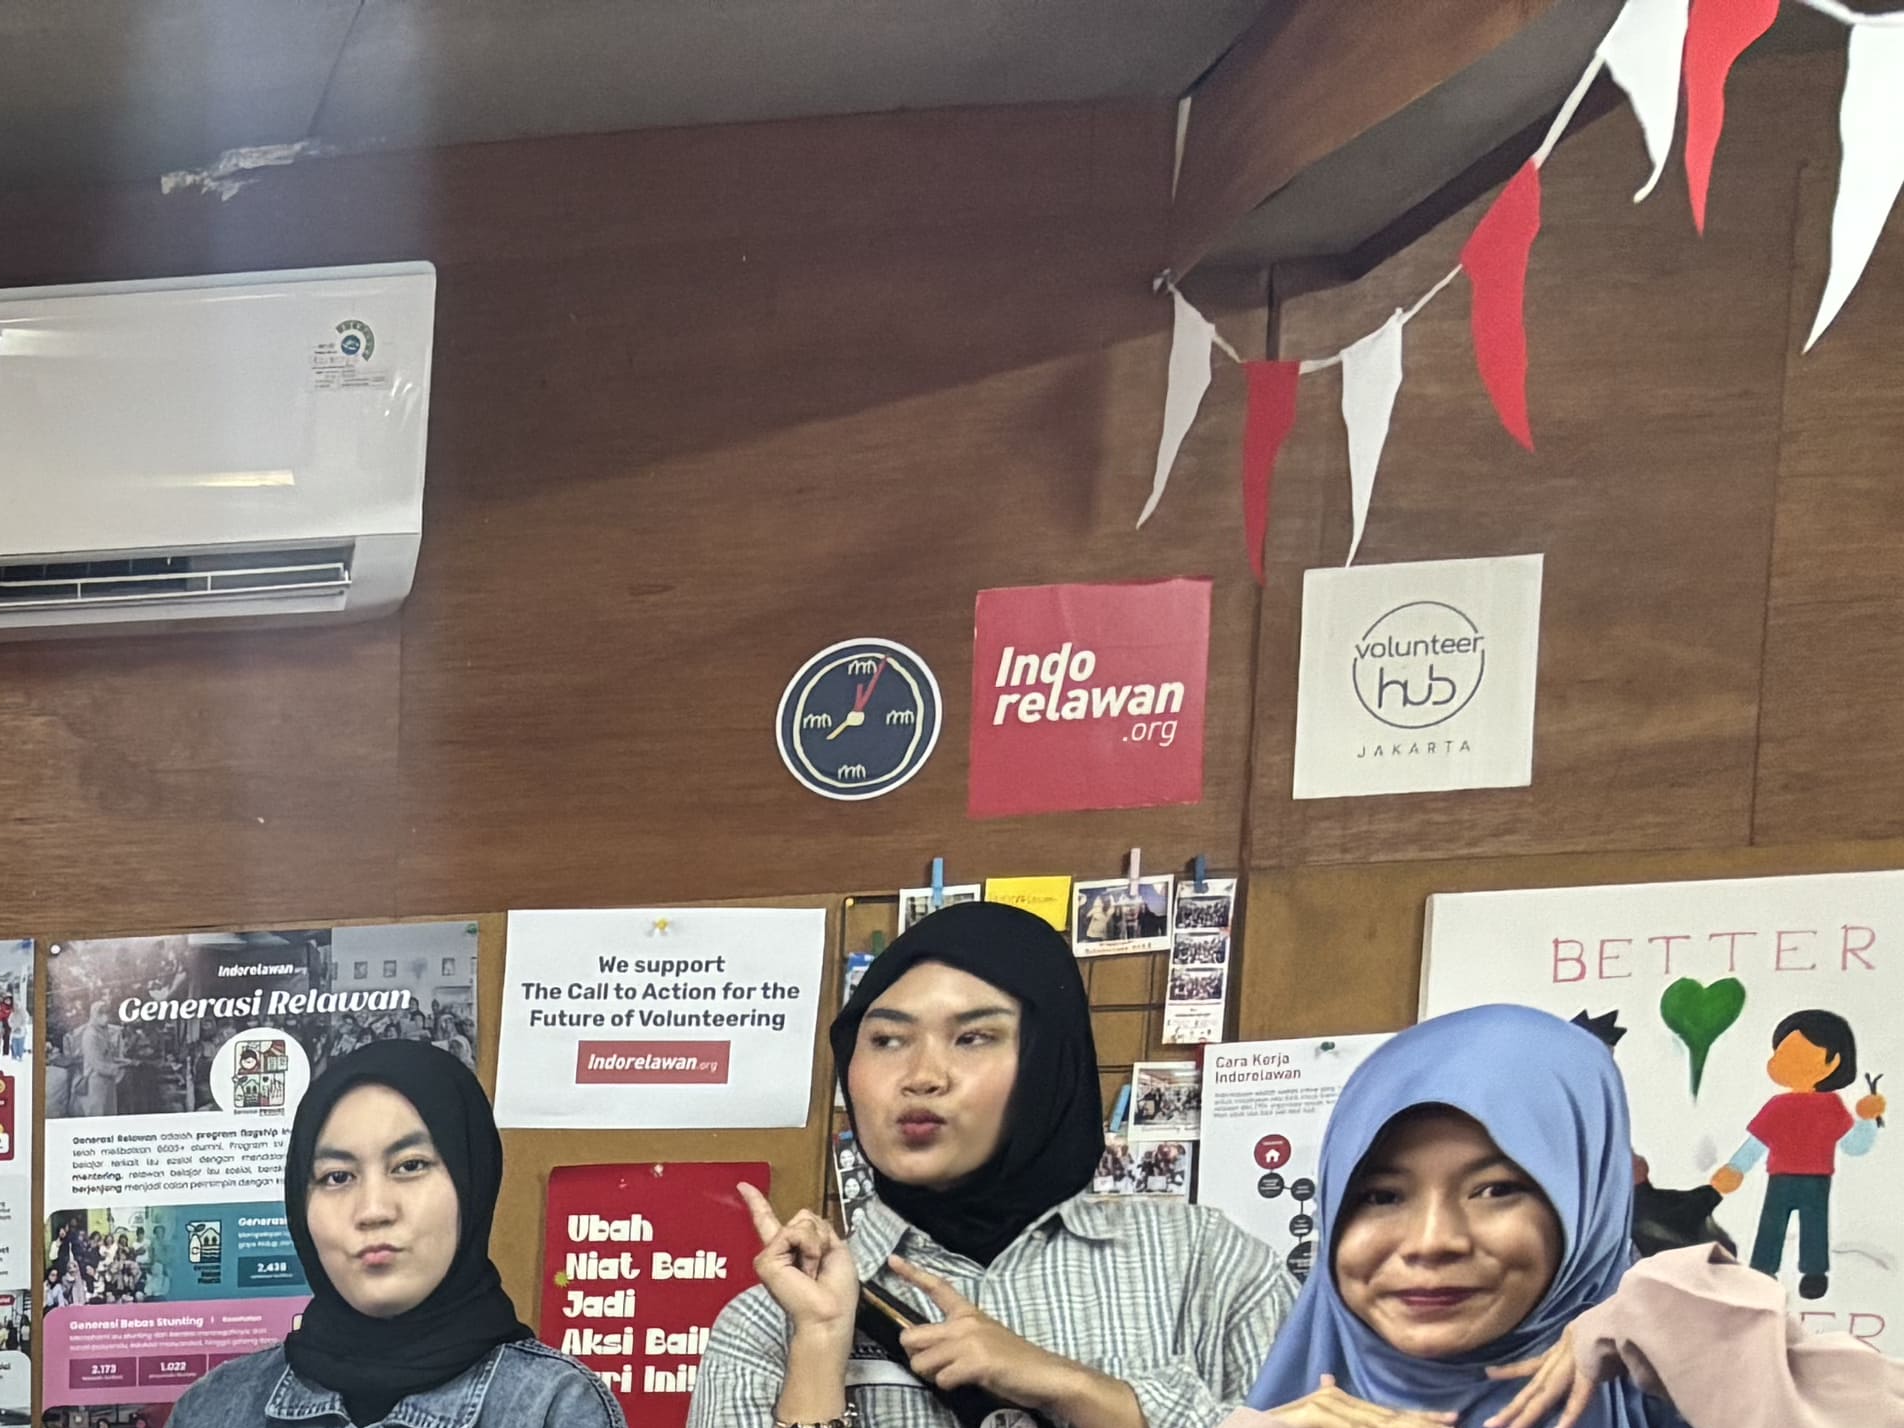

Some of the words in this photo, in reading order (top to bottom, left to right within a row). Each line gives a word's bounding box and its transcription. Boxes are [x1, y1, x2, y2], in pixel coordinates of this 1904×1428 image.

[1355, 636, 1484, 660] volunteer
[994, 642, 1097, 688] Indo
[1377, 664, 1457, 709] hub
[992, 681, 1185, 726] relawan
[1122, 719, 1178, 747] .org
[1357, 740, 1471, 759] JAKARTA
[598, 955, 630, 974] We
[634, 954, 726, 977] support
[1550, 925, 1878, 984] BETTER
[522, 982, 560, 1001] The
[567, 982, 608, 1001] Call
[613, 984, 637, 1001] to
[641, 982, 717, 1001] Action
[722, 981, 754, 1000] for
[760, 981, 801, 1000] the
[118, 993, 261, 1023] Generasi
[268, 988, 411, 1015] Relawan
[530, 1010, 604, 1028] Future
[610, 1009, 635, 1028] of
[638, 1009, 787, 1032] Volunteering
[1216, 1055, 1248, 1068] Cara
[1253, 1053, 1290, 1068] Kerja
[1215, 1068, 1302, 1084] Indorelawan
[196, 1131, 237, 1141] program
[199, 1154, 235, 1166] dengan
[567, 1214, 654, 1243] Ubah
[565, 1251, 641, 1281] Niat
[652, 1250, 728, 1280] Baik
[562, 1289, 637, 1319] Jadi
[70, 1319, 119, 1331] Generasi
[121, 1317, 155, 1329] Bebas
[157, 1315, 204, 1330] Stunting
[560, 1326, 635, 1356] Aksi
[644, 1363, 697, 1393] Ini!
